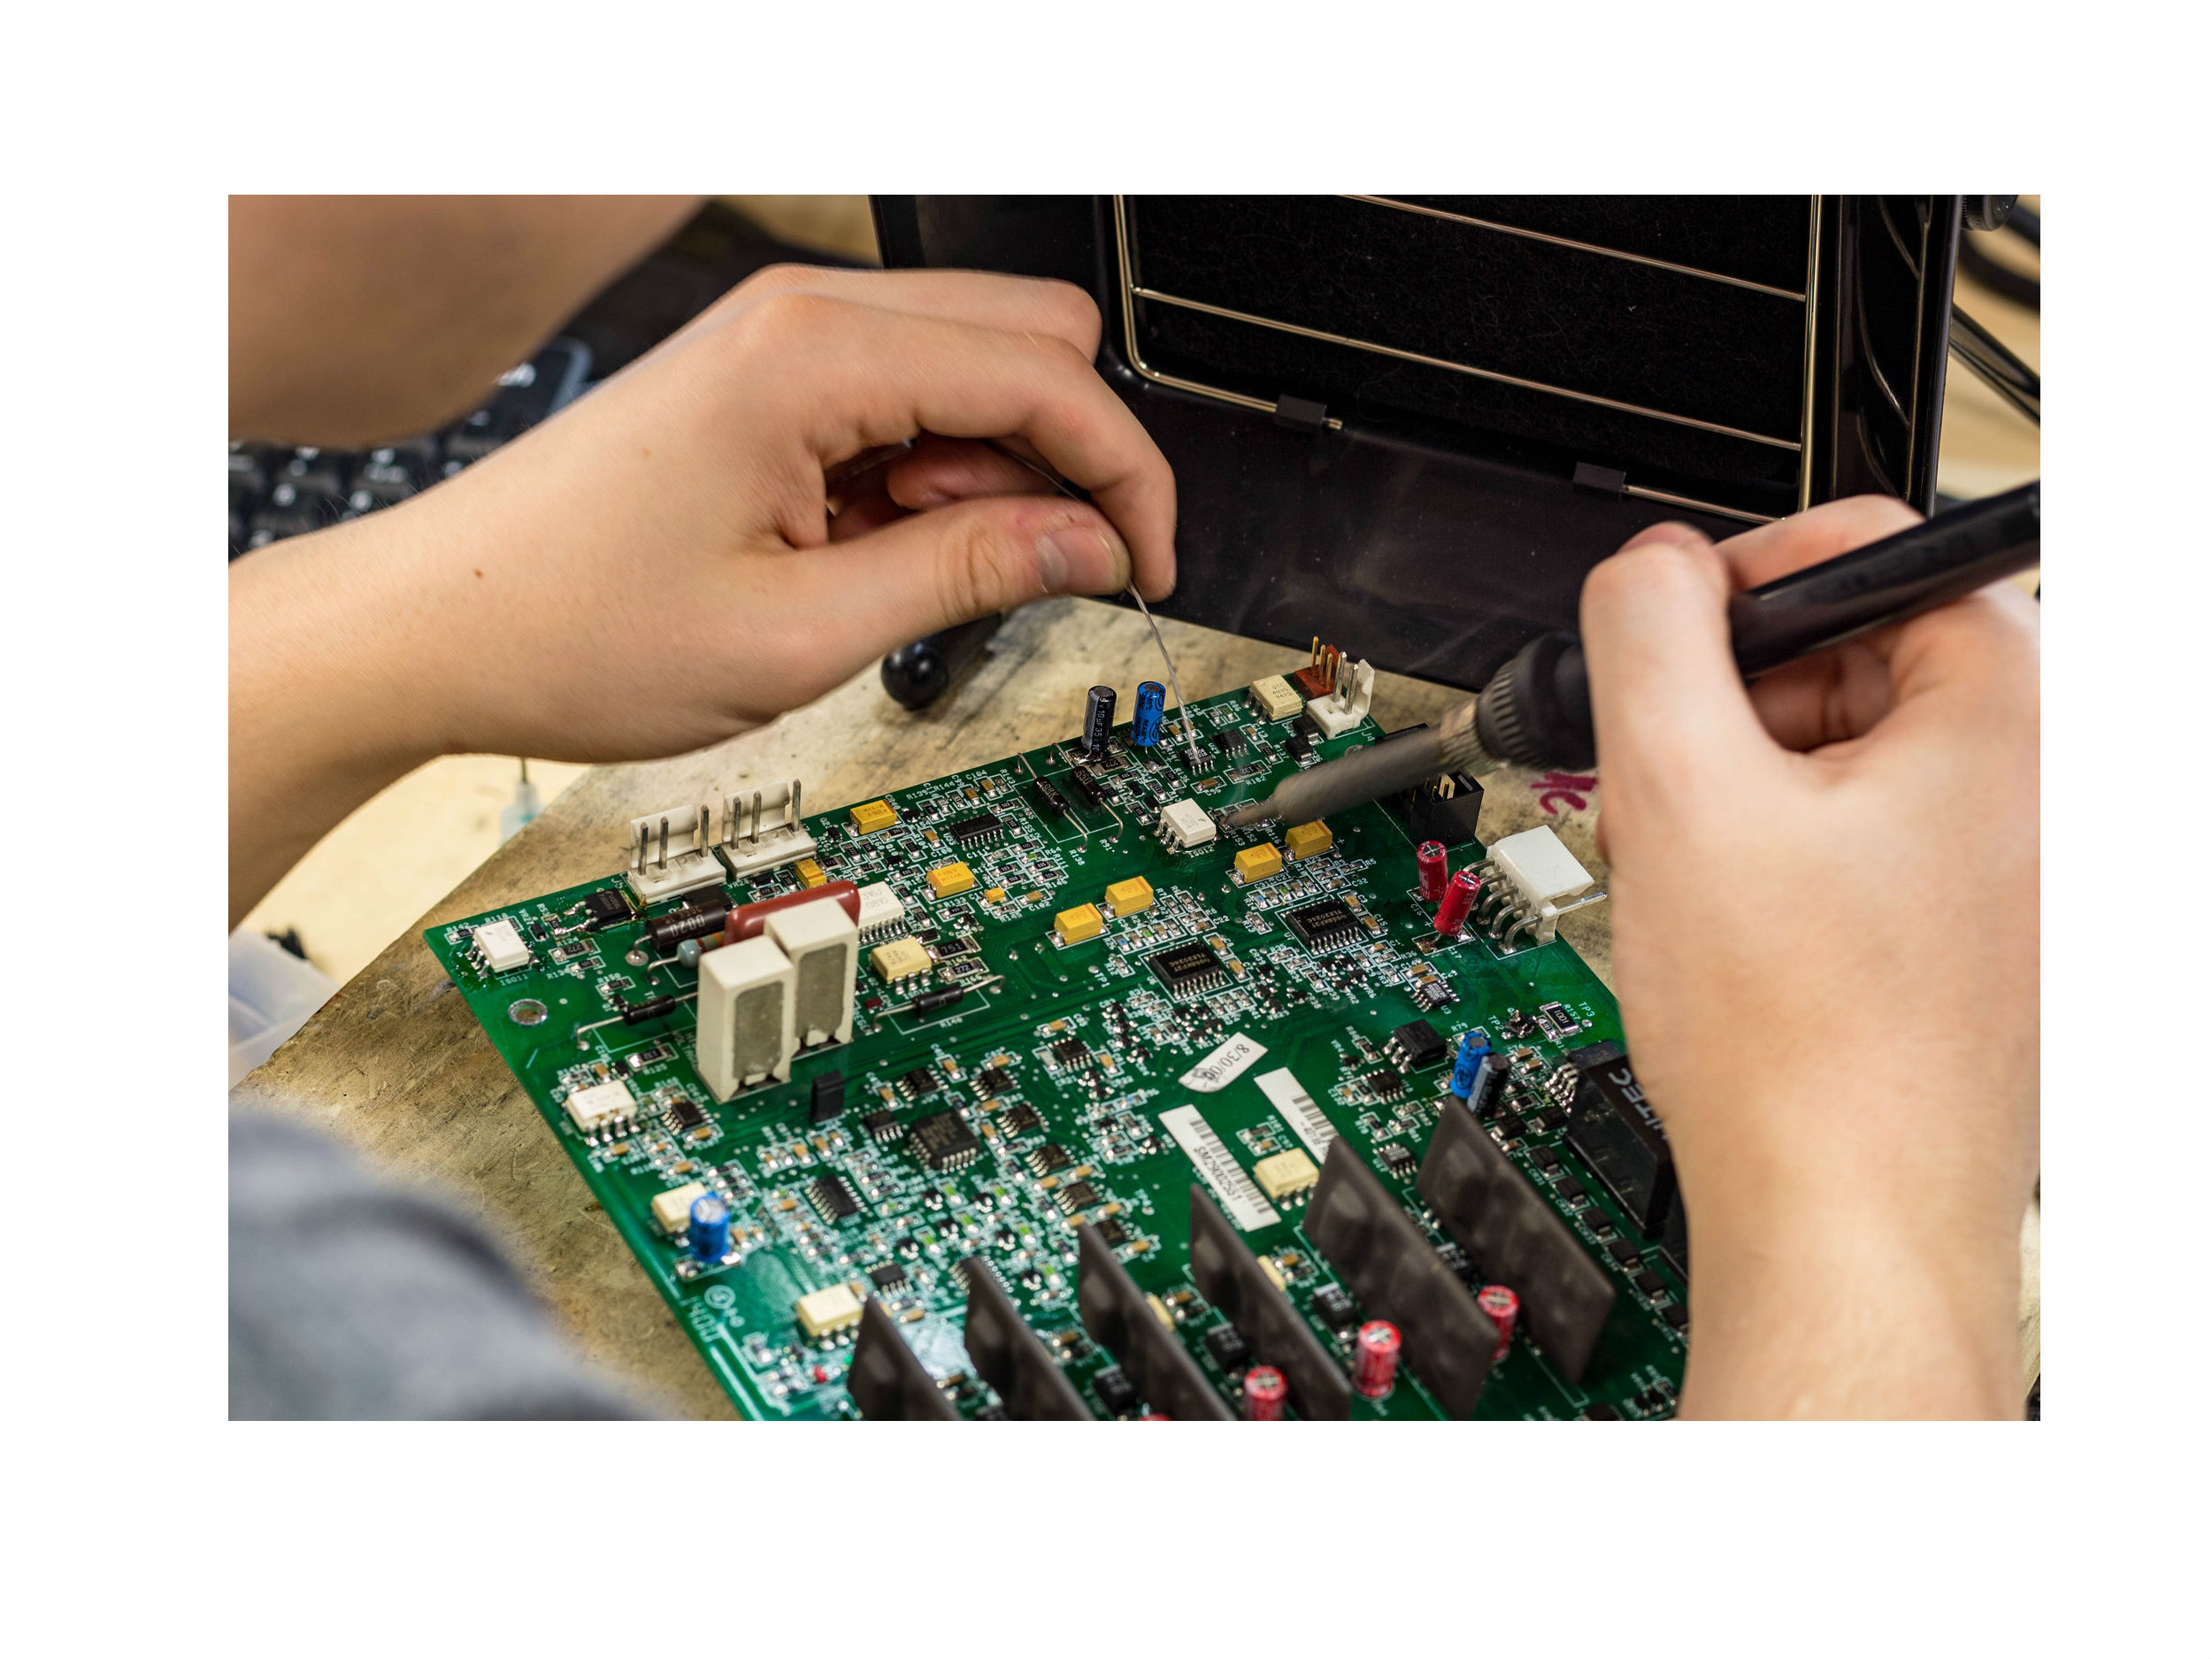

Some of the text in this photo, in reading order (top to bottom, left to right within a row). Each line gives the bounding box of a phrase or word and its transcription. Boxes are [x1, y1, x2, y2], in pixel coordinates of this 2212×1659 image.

[1229, 831, 1246, 847] R153
[1265, 827, 1282, 844] R116
[1351, 878, 1369, 887] C32
[1212, 915, 1230, 925] C22
[1373, 913, 1388, 927] C15
[941, 942, 963, 954] 751
[956, 964, 970, 974] 272
[1094, 972, 1110, 988] TP1
[1553, 1008, 1571, 1025] 1001
[1563, 1003, 1582, 1020] R157
[1578, 1002, 1595, 1018] TP3
[1487, 1015, 1504, 1031] TP2
